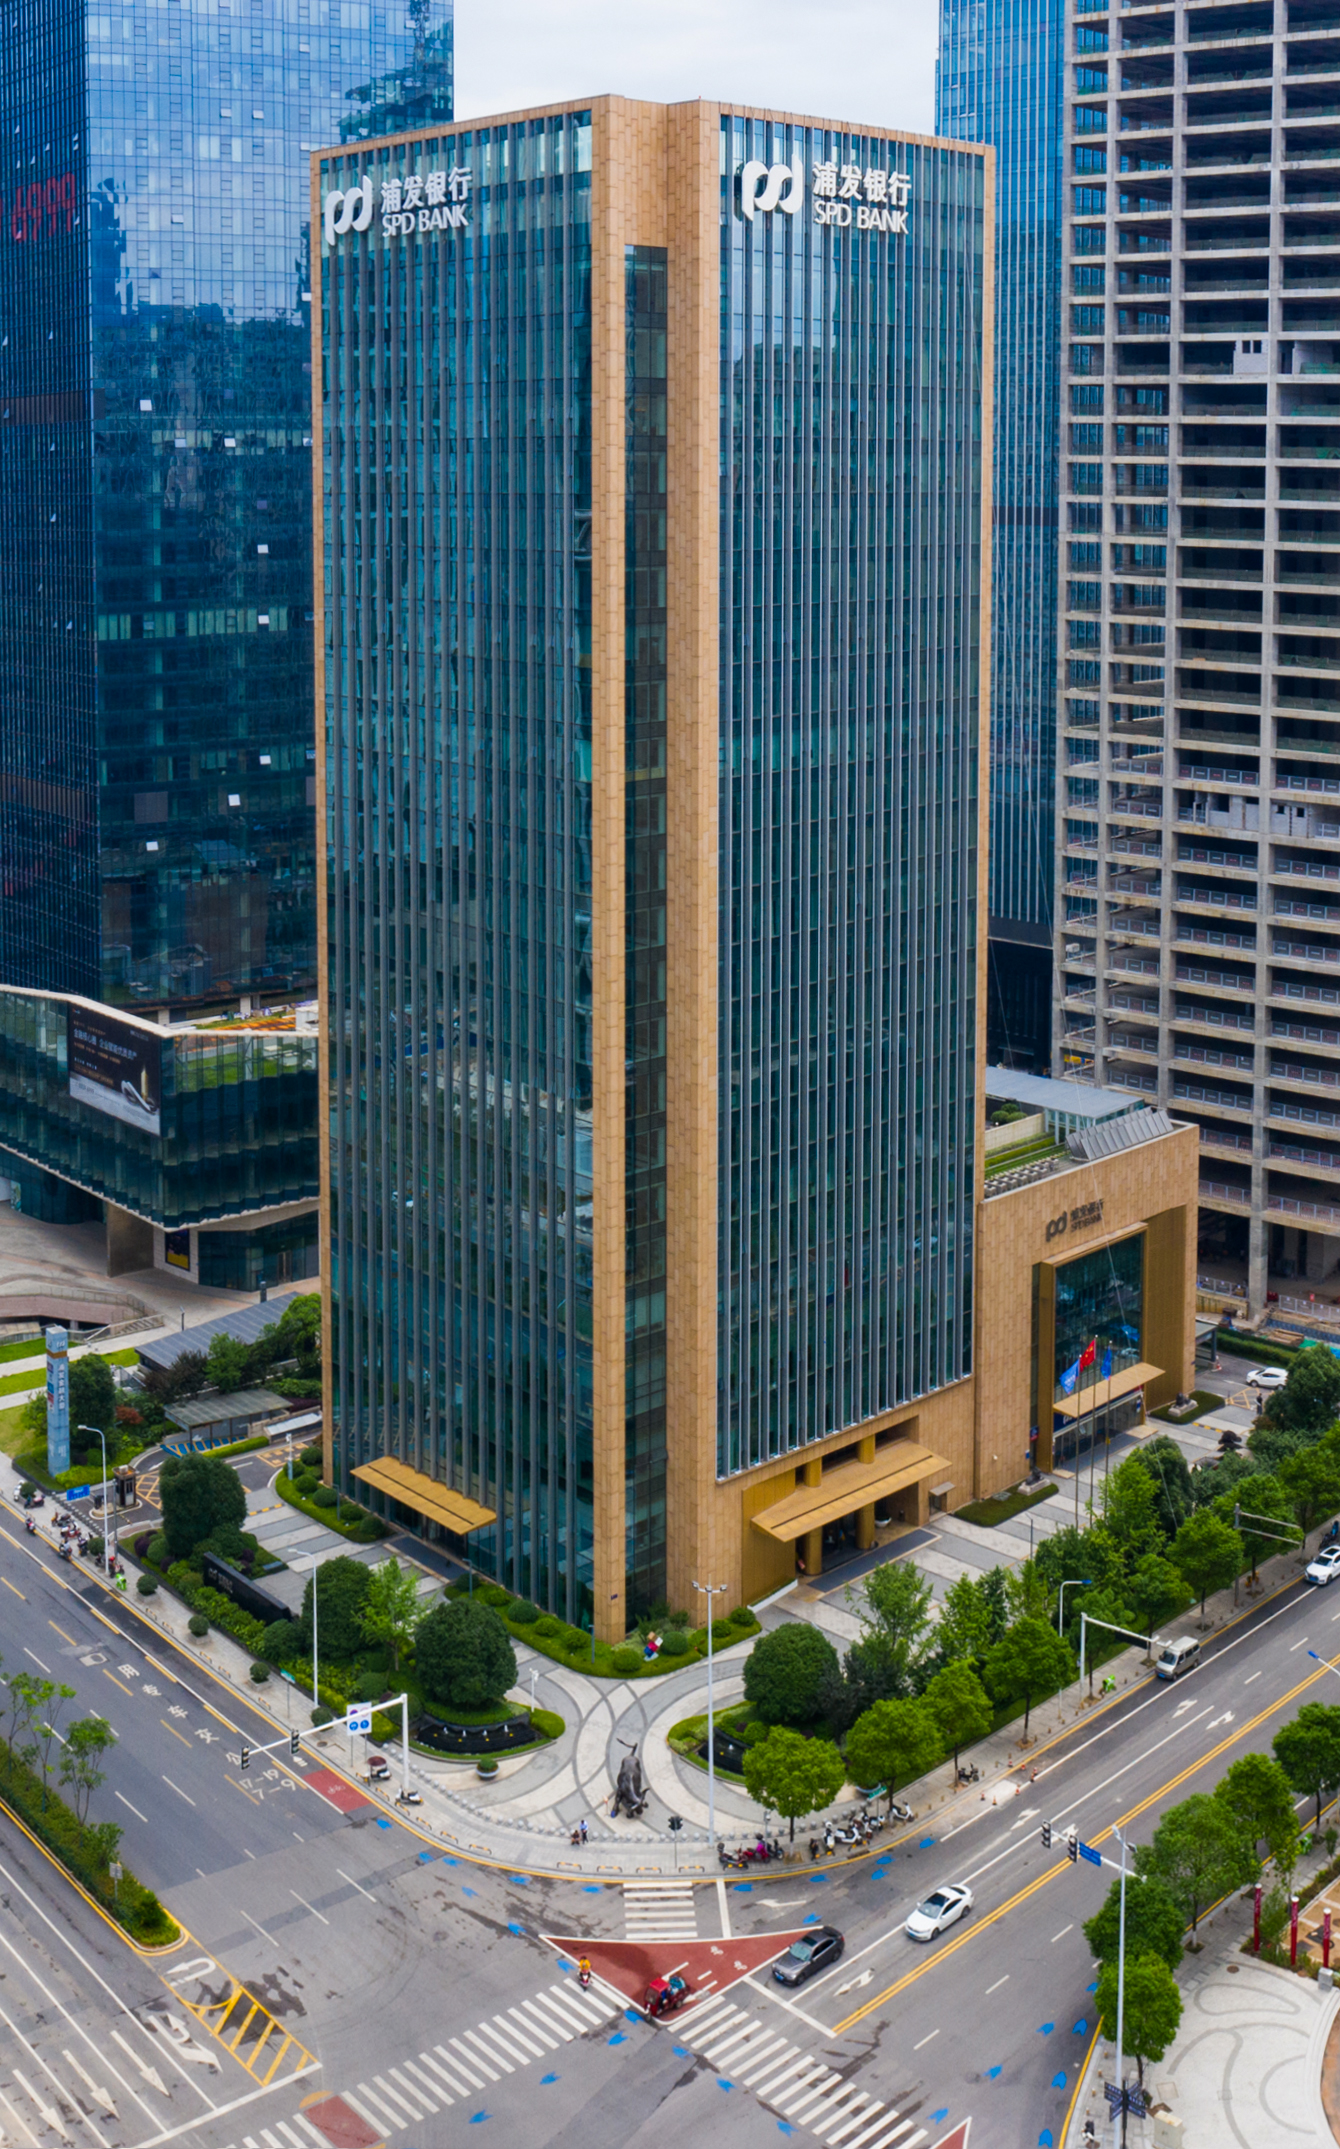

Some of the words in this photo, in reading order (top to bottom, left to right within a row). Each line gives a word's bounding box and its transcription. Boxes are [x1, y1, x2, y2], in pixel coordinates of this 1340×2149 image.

[380, 166, 473, 213] 浦发银行
[812, 161, 912, 207] 浦发银行
[382, 212, 415, 237] SPD
[418, 203, 469, 232] BANK
[814, 200, 852, 227] SPD
[857, 206, 909, 235] BANK
